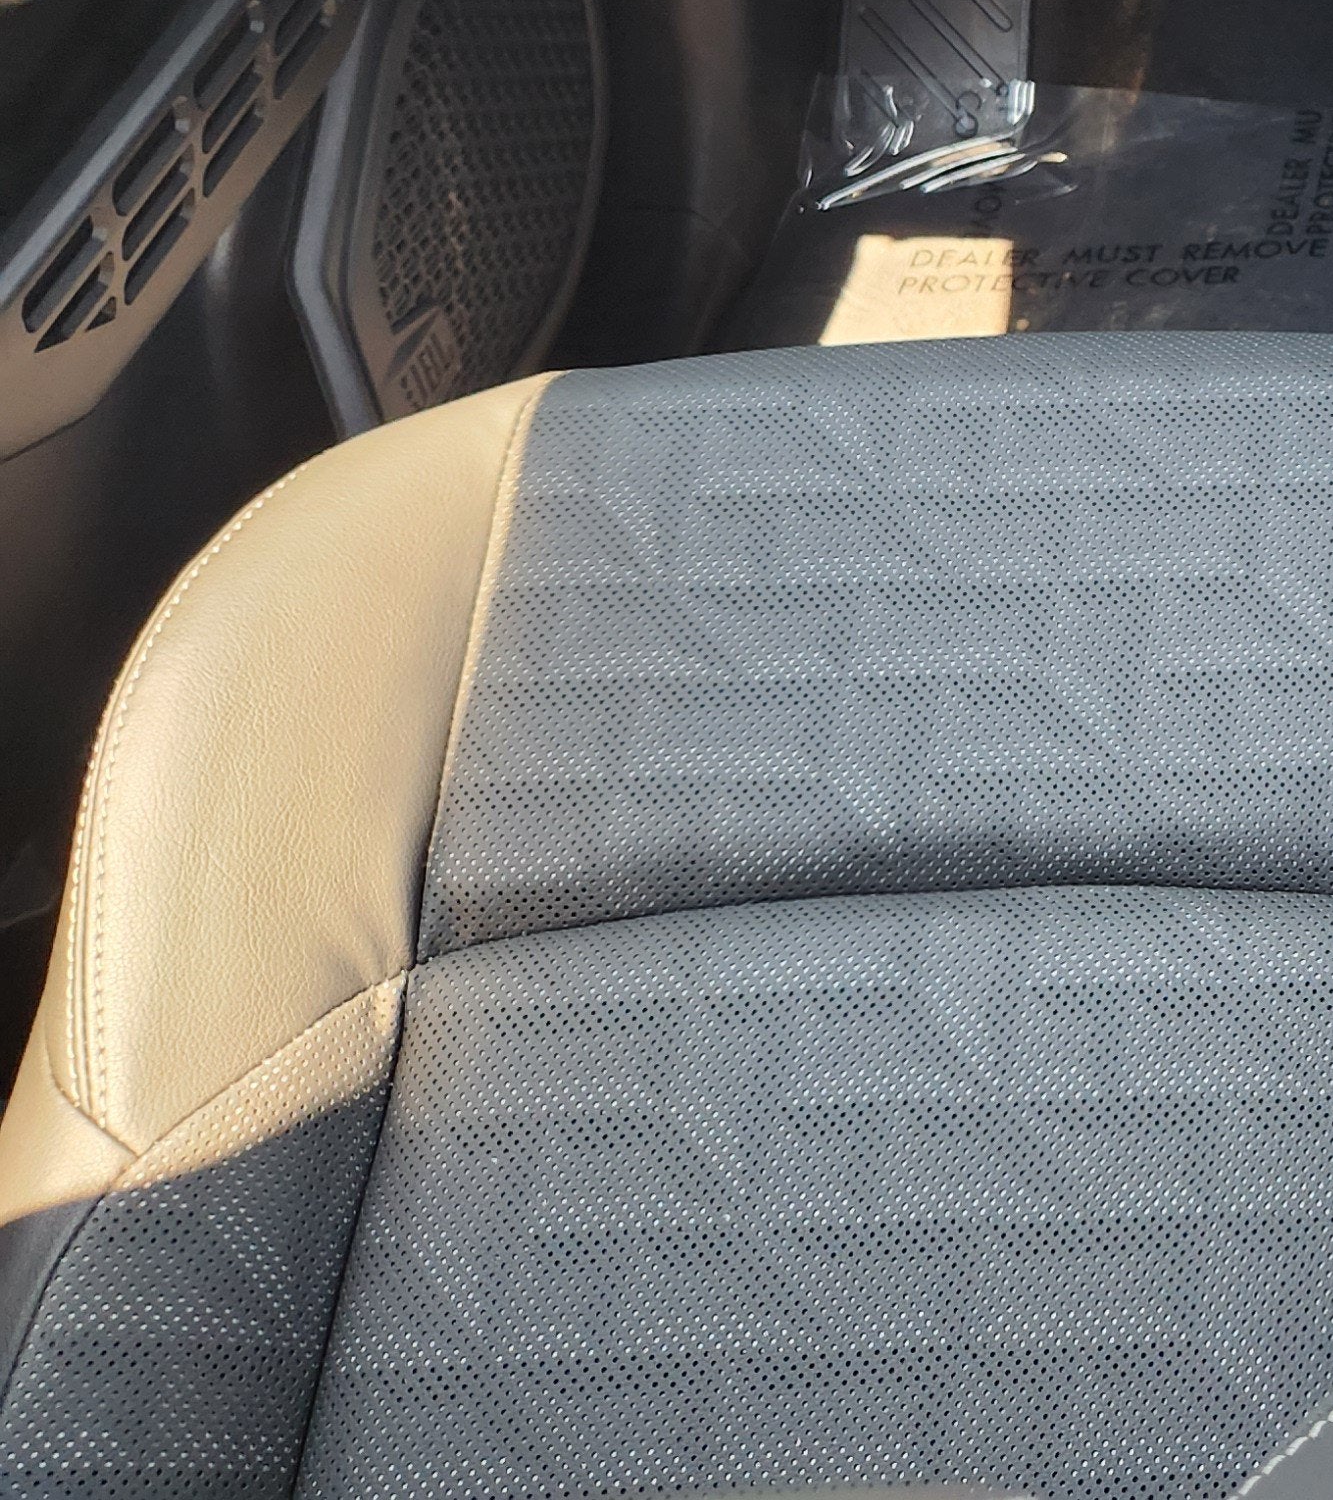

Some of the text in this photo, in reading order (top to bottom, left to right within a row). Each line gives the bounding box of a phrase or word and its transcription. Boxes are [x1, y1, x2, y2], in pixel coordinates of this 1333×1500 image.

[1267, 157, 1313, 236] DEALER
[909, 238, 1329, 270] DEALER MUST REMOVE
[898, 265, 1241, 295] PROTECTIVE COVER
